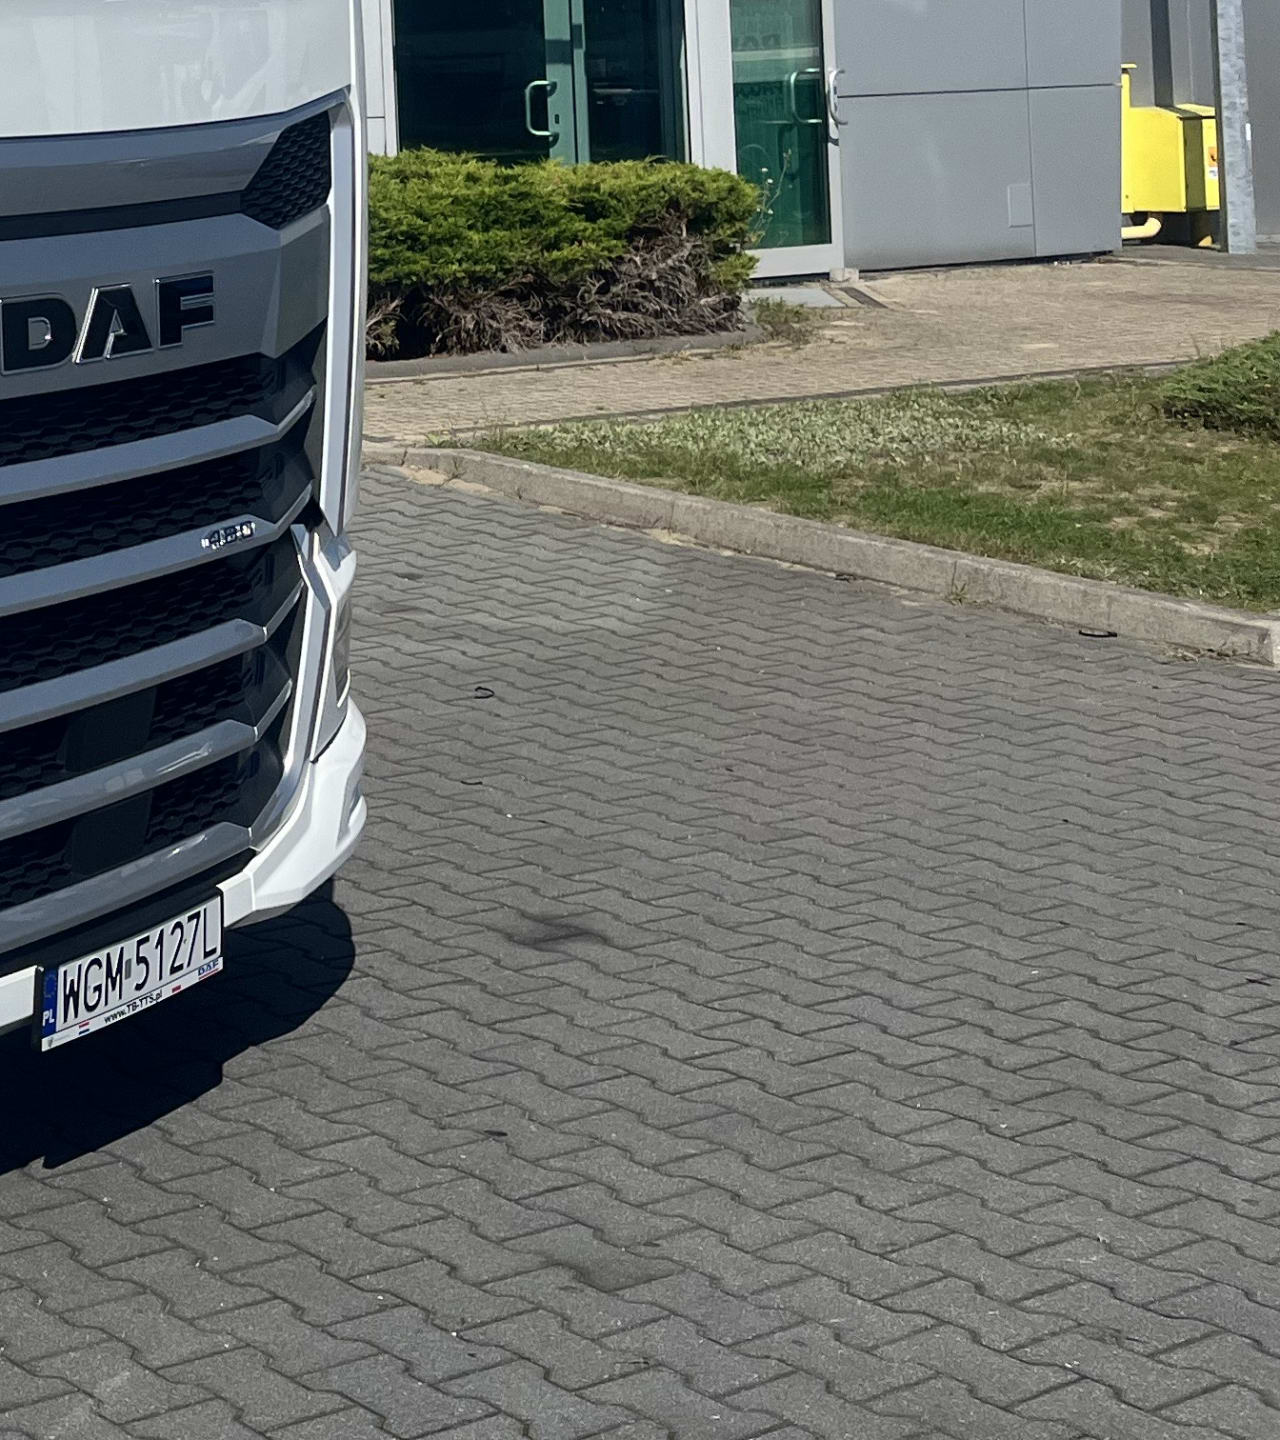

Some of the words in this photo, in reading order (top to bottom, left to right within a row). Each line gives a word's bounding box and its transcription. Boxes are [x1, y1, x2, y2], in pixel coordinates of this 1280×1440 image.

[63, 946, 124, 1024] WGM
[134, 907, 217, 992] 5127L
[42, 1009, 56, 1027] PL
